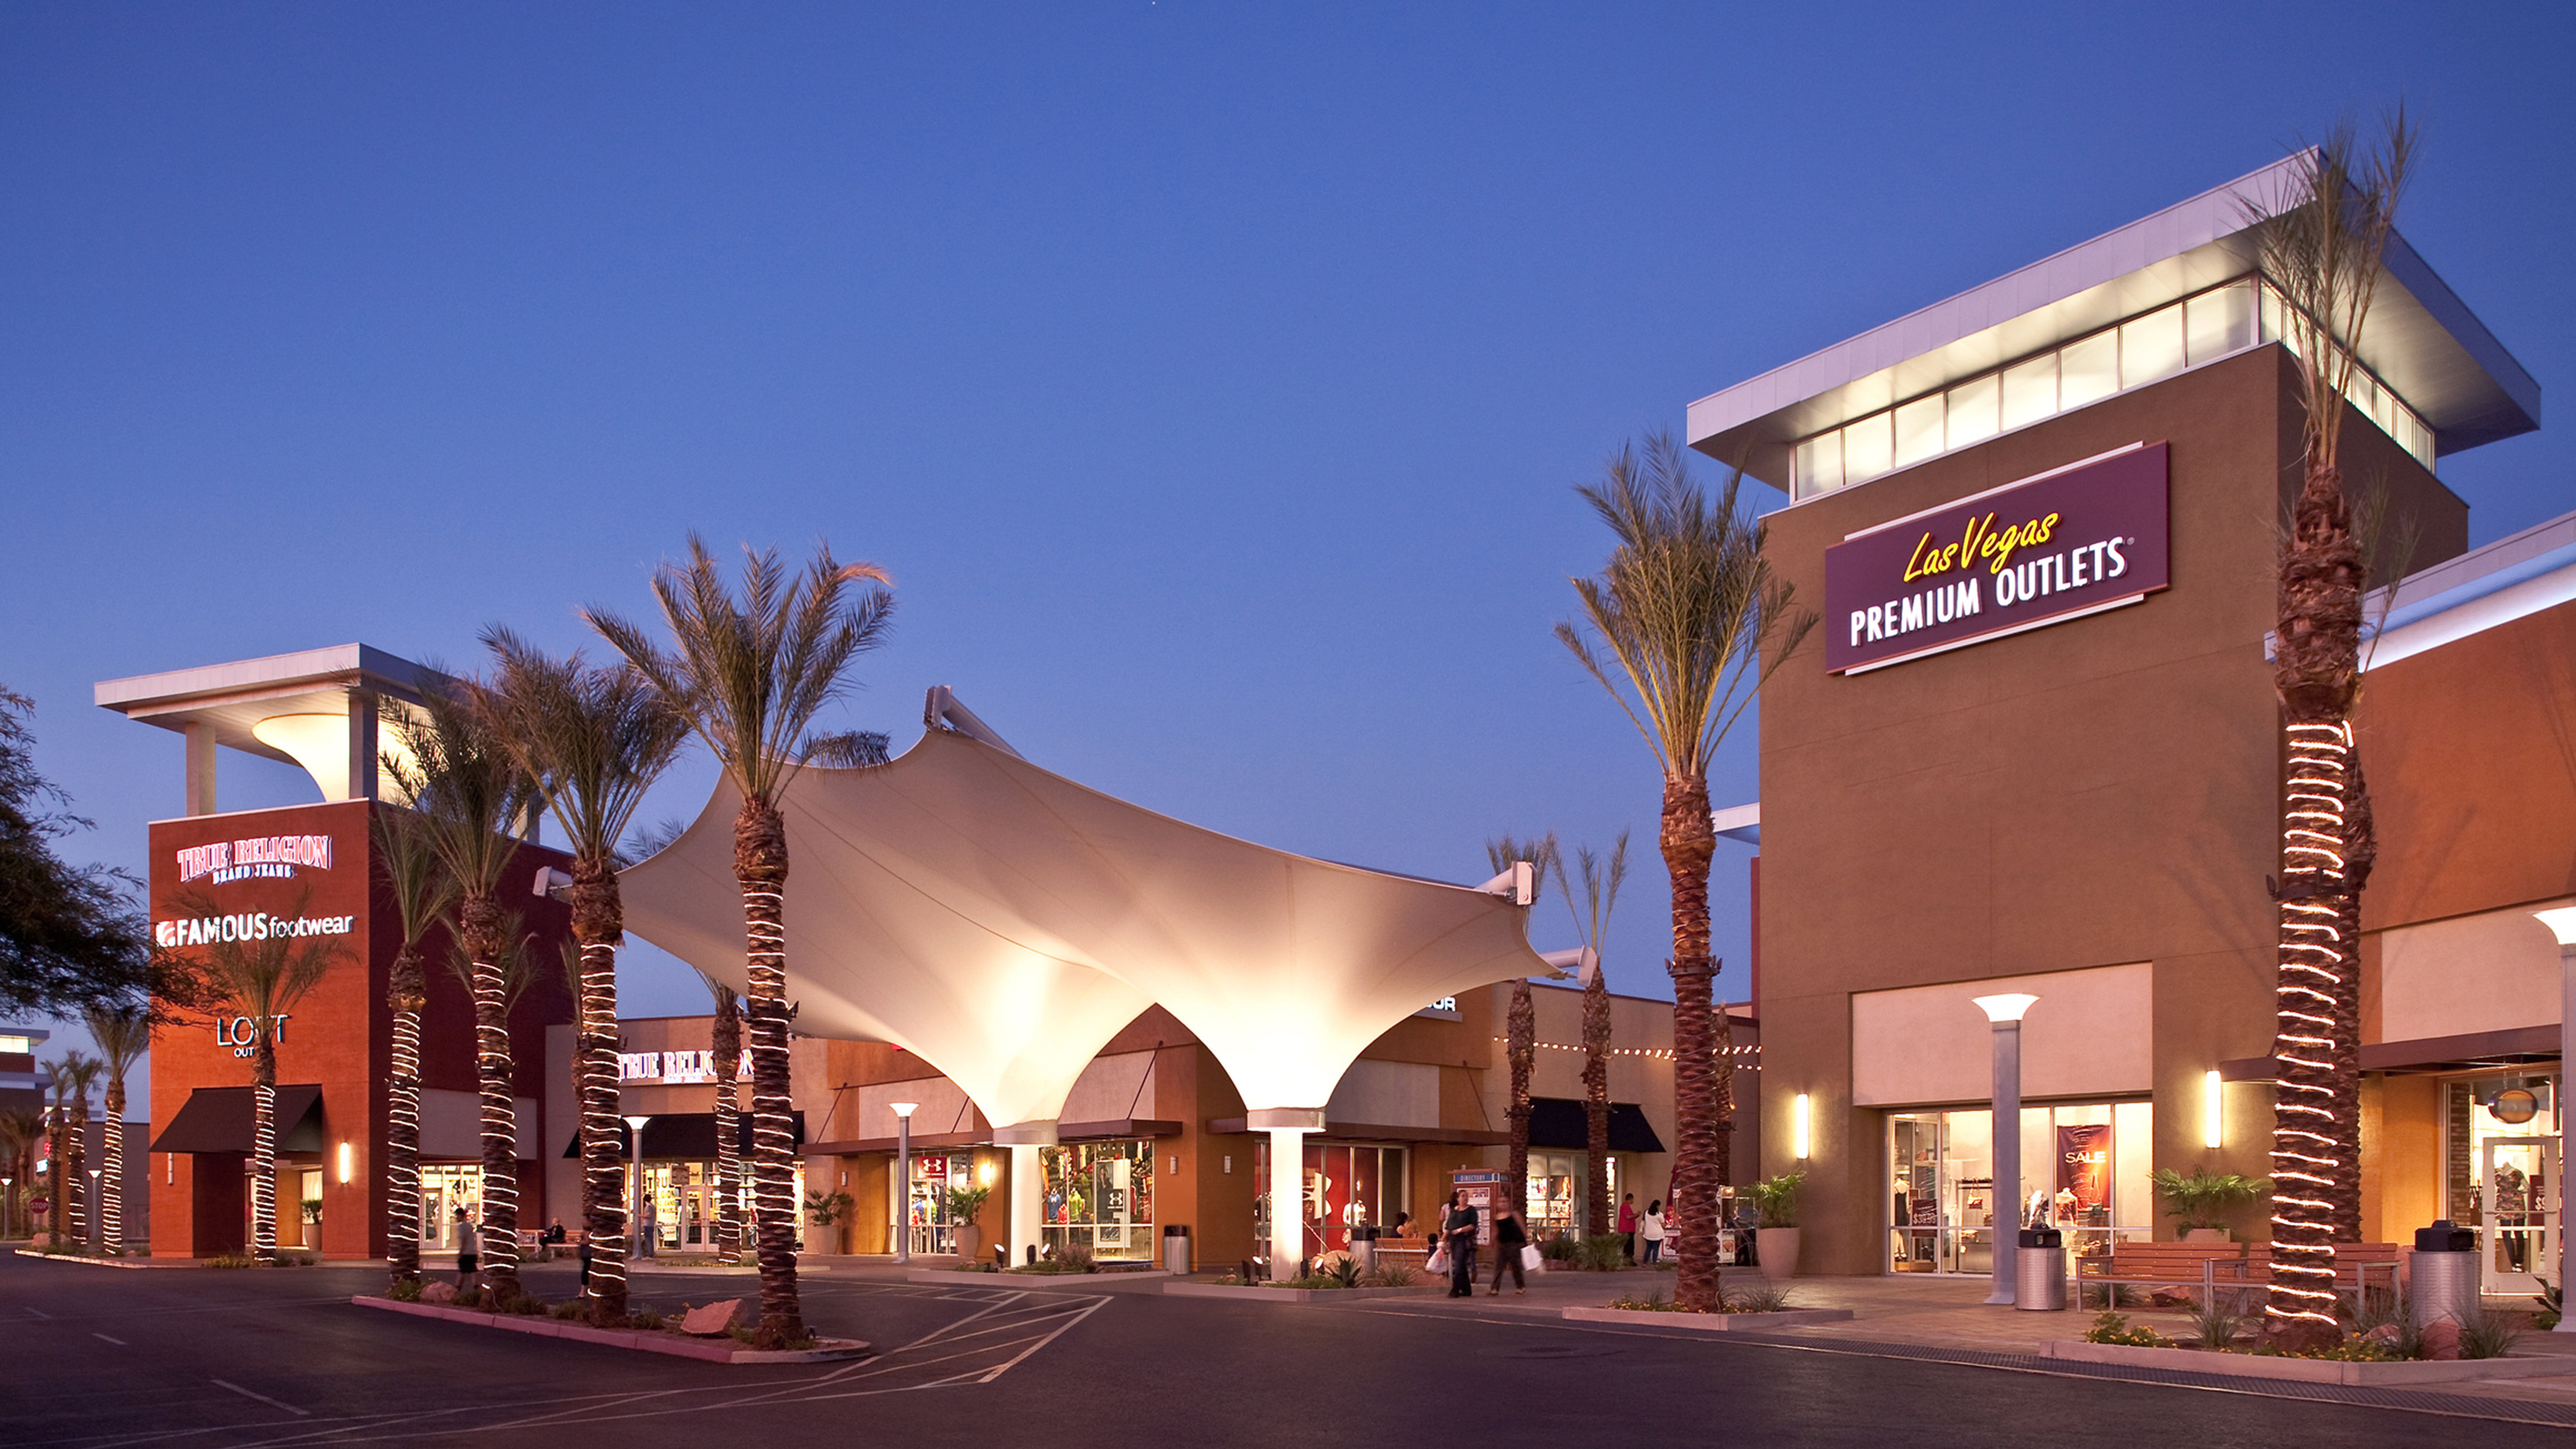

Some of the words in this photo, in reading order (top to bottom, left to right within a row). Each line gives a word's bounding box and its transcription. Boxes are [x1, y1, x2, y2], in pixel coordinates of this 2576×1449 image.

[1903, 531, 1959, 582] Las
[1961, 511, 2059, 574] Vegas
[1851, 577, 1980, 646] PREMIUM
[177, 842, 229, 882] TRUE
[234, 835, 329, 869] RELIGION
[213, 865, 251, 884] BRAND
[255, 864, 291, 877] JEANS
[217, 1014, 288, 1046] LOT
[234, 1047, 254, 1058] OUT
[617, 1052, 660, 1079] TRUE
[2065, 1152, 2106, 1163] SALE
